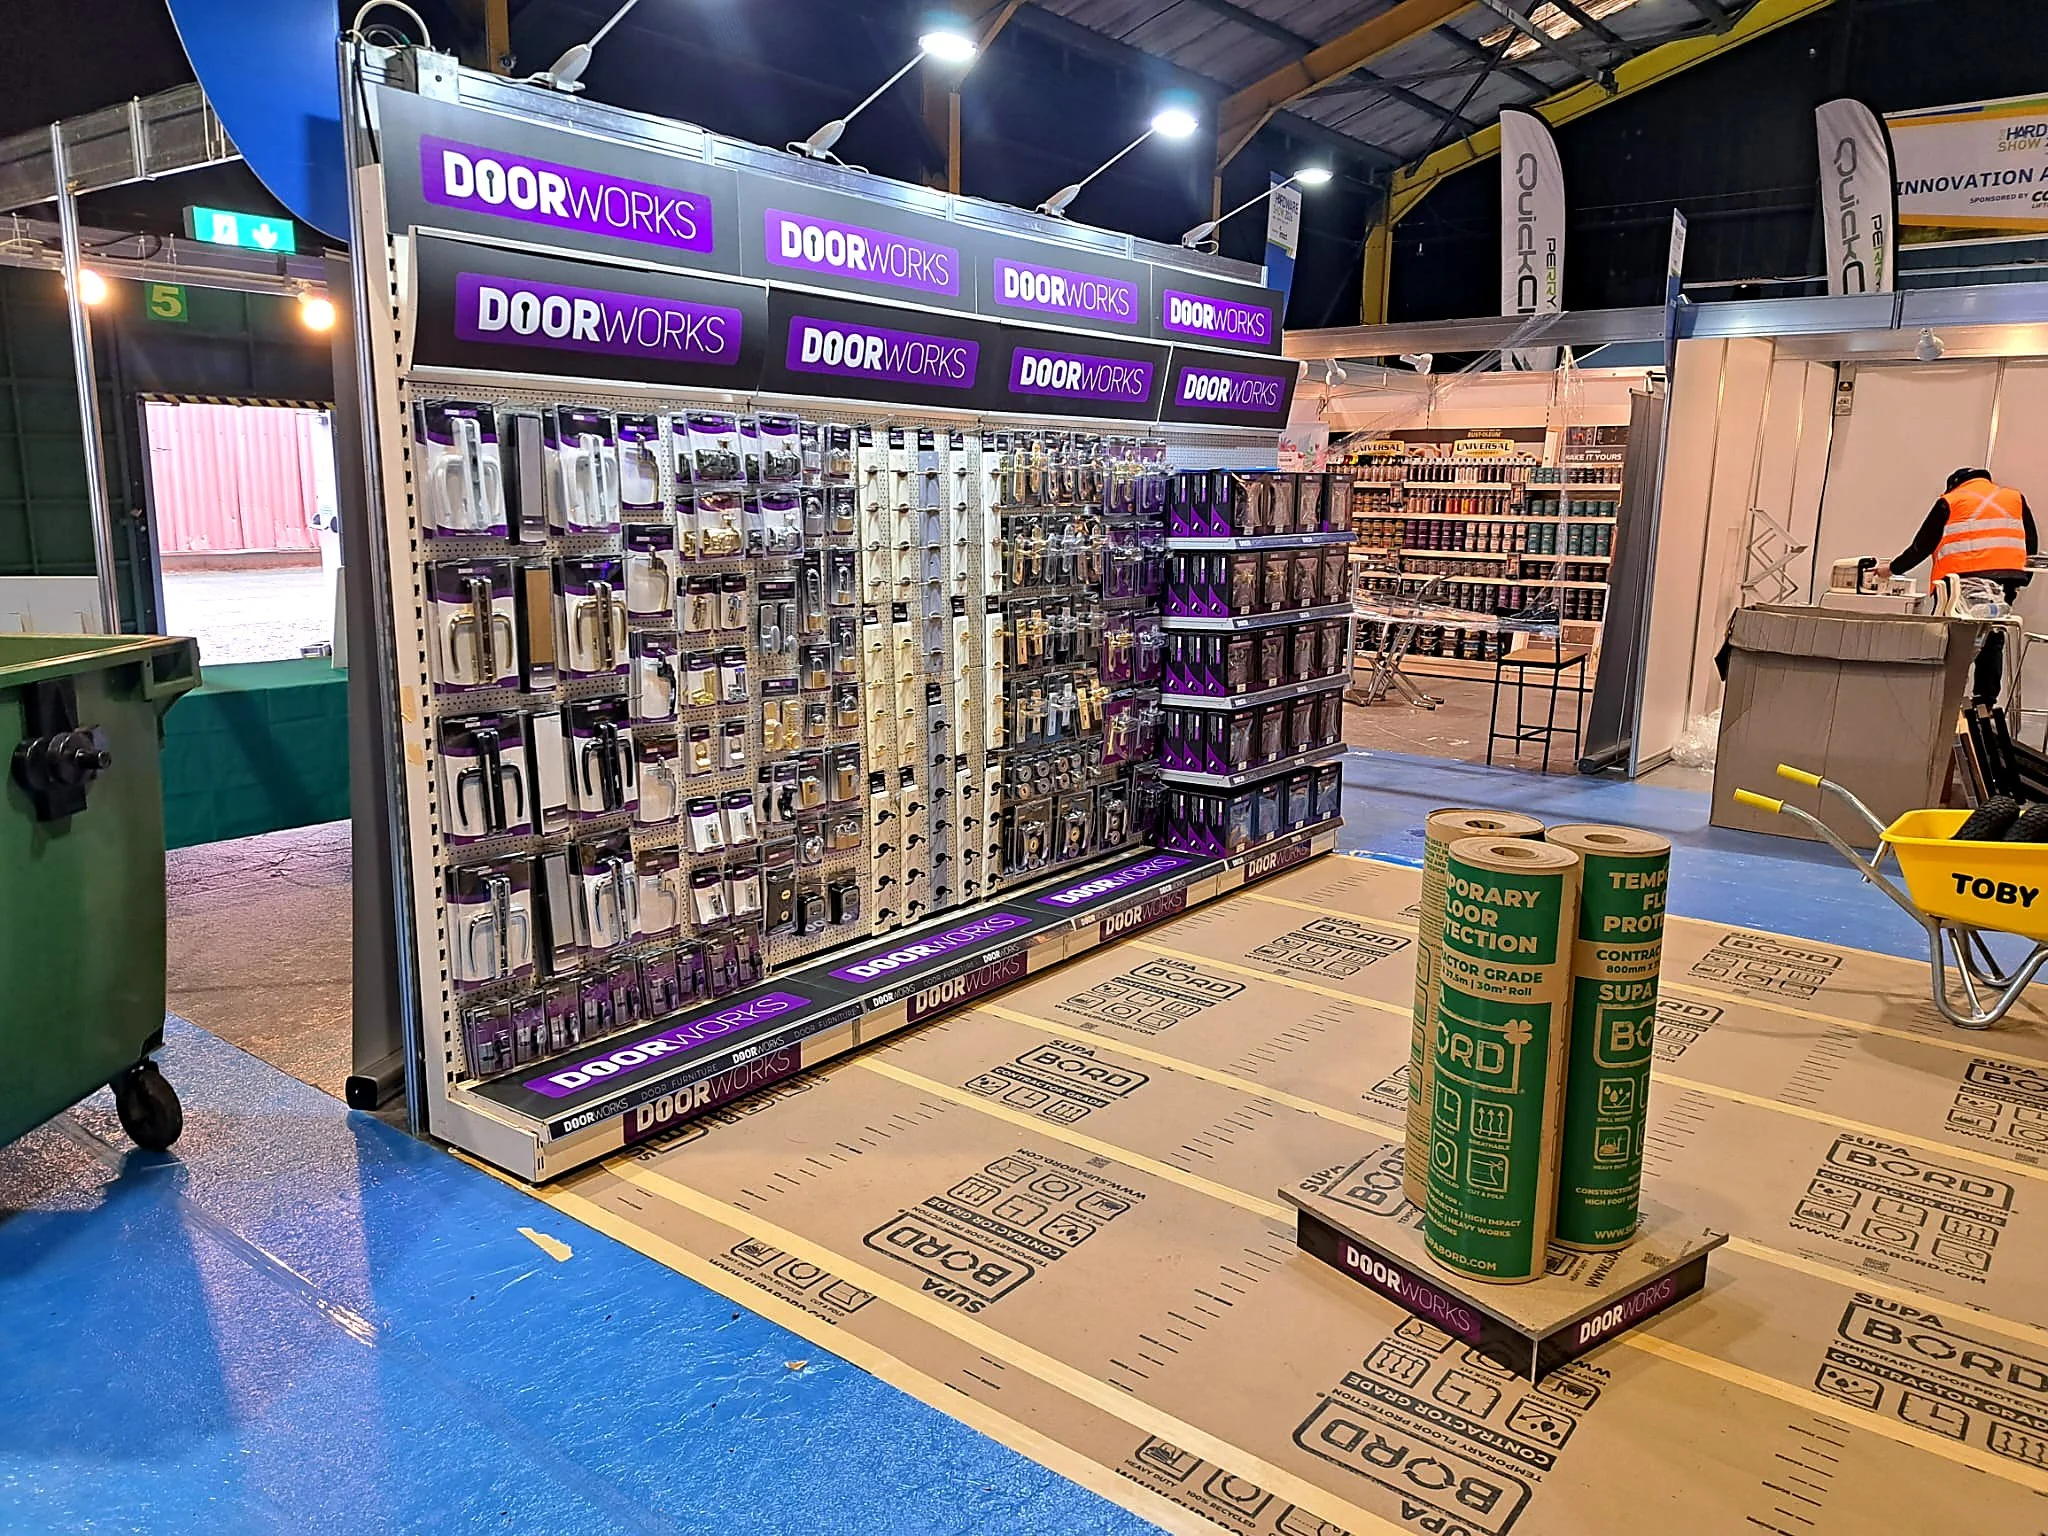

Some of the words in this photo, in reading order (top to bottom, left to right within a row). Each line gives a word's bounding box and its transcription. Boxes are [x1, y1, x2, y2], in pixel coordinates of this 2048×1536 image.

[442, 149, 697, 241] DOORWORKS
[1897, 168, 2034, 195] INNOVATION
[1969, 194, 2017, 204] SPONSORED
[780, 220, 950, 287] DOORWORKS
[152, 286, 181, 317] 5
[1004, 267, 1130, 316] DOORWORKS
[478, 286, 725, 354] DOORWORKS
[1170, 297, 1265, 338] DOORWORKS
[802, 327, 967, 379] DOORWORKS
[1019, 355, 1145, 396] DOORWORKS
[1183, 372, 1278, 406] DOORWORKS
[1456, 441, 1511, 452] UNIVERSAL
[1595, 453, 1622, 461] YOURS
[1051, 857, 1177, 905] DOORWORKS
[1951, 872, 2040, 908] TOBY
[1105, 893, 1183, 936] DOORWORKS
[1315, 923, 1399, 946] BORD
[846, 914, 1016, 978] DOORWORKS
[1156, 957, 1197, 972] SUPA
[1732, 940, 1831, 963] BORD
[916, 956, 1020, 1015] DOORWORKS
[1144, 965, 1232, 994] BORD
[1484, 968, 1543, 984] GRADE
[1509, 987, 1532, 996] Roll
[1599, 981, 1653, 1001] SUPA
[548, 997, 789, 1089] DOORWORKS
[1049, 1039, 1096, 1057] SUPA
[564, 1098, 629, 1132] DOORWORKS
[640, 1082, 667, 1100] DOOR
[671, 1063, 718, 1093] FURNITURE
[732, 1036, 785, 1065] DOORWORKS
[793, 1023, 816, 1039] DOOR
[994, 1068, 1066, 1094] CONTRACTOR
[1066, 1090, 1107, 1108] GRADE
[1033, 1052, 1132, 1087] BORD
[636, 1048, 791, 1133] DOORWORKS
[1839, 1133, 1910, 1157] SUPA
[1016, 1147, 1147, 1201] WWW.SUPABORD.COM
[1846, 1150, 1994, 1198] BORD
[927, 1198, 972, 1219] GRADE
[1820, 1171, 1936, 1206] CONTRACTOR
[1940, 1205, 2005, 1226] GRADE
[973, 1216, 1061, 1258] CONTRACTOR
[1488, 1217, 1522, 1227] IMPACT
[886, 1225, 1013, 1287] BORD
[1788, 1221, 1987, 1284] WWW.SUPABORD.COM
[921, 1277, 986, 1313] SUPA
[1346, 1245, 1472, 1332] DOORWORKS
[1579, 1277, 1672, 1345] DOORWORKS
[1853, 1292, 1944, 1328] SUPA
[1831, 1352, 1980, 1409] CONTRACTOR
[1832, 1339, 1918, 1371] TEMPORARY
[1921, 1368, 1971, 1390] FLOOR
[1331, 1388, 1411, 1426] PROTECTION
[1346, 1375, 1412, 1407] GRADE
[1412, 1421, 1458, 1446] FLOOR
[1414, 1404, 1550, 1464] CONTRACTOR
[1124, 1459, 1153, 1476] HEAVY
[1153, 1472, 1177, 1488] DUTY
[1320, 1418, 1505, 1515] BORD
[1459, 1443, 1543, 1483] TEMPORARY
[1210, 1502, 1256, 1529] RECYCLED
